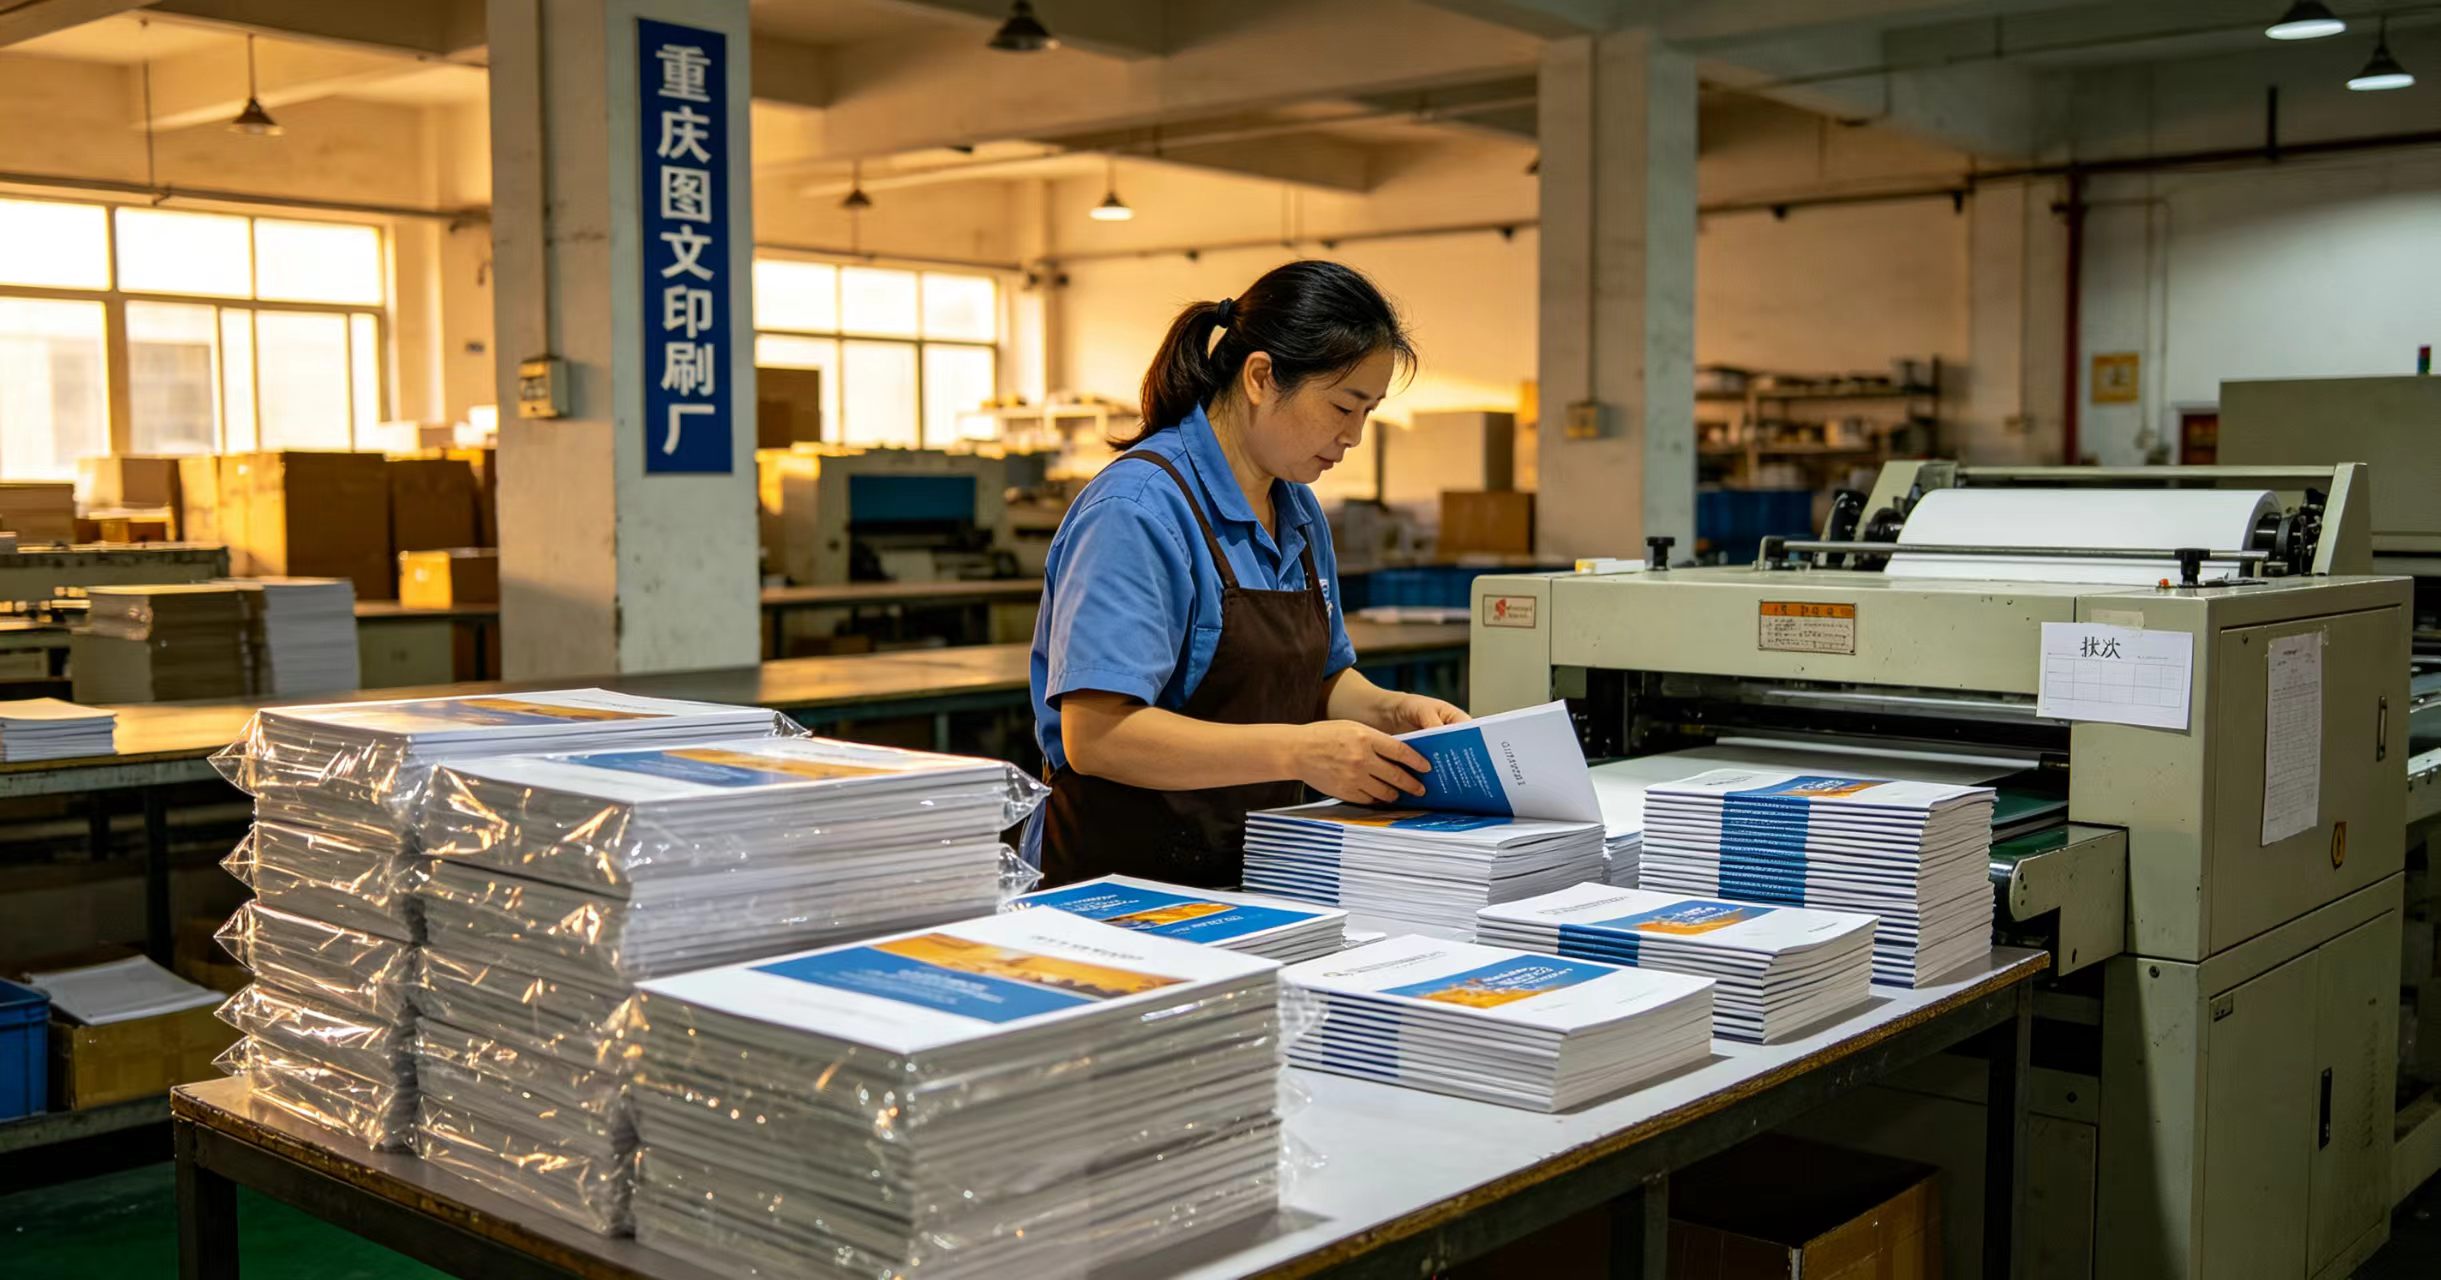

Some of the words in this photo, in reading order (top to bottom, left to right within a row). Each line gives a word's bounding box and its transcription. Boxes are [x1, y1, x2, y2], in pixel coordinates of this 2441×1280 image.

[656, 44, 716, 456] 重庆图文印刷厂
